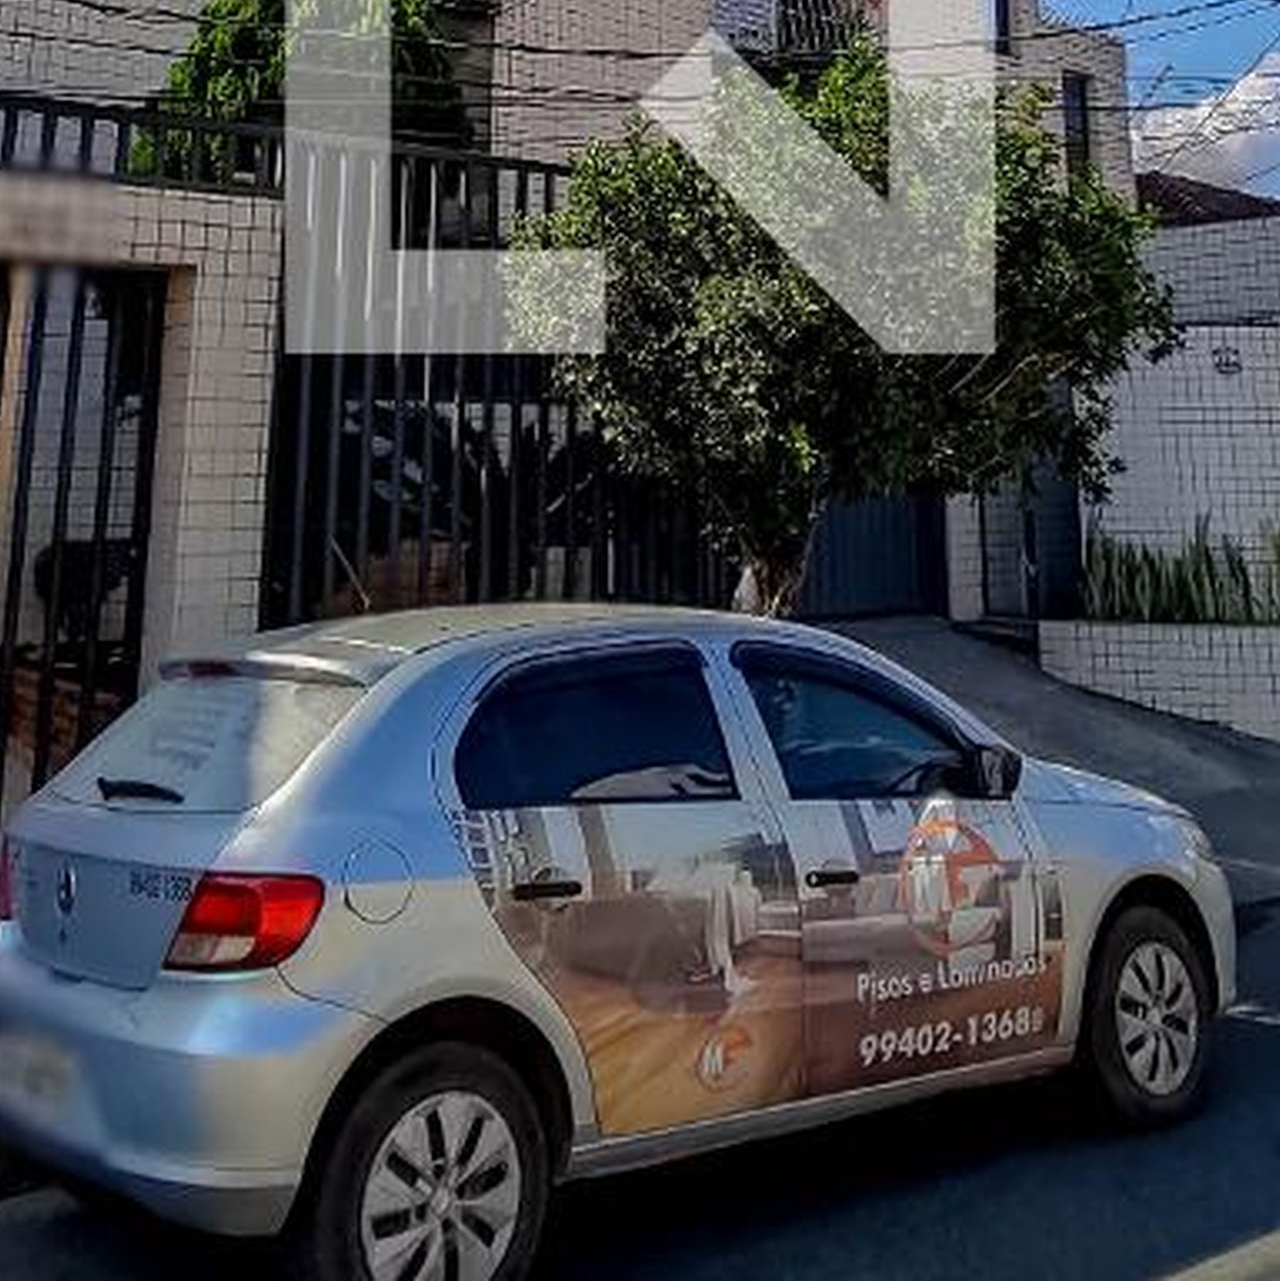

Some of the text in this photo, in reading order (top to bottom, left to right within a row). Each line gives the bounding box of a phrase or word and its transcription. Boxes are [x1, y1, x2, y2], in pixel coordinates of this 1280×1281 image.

[857, 970, 913, 1003] Pisos
[920, 971, 933, 994] e
[858, 1006, 1031, 1067] 99402-1368
